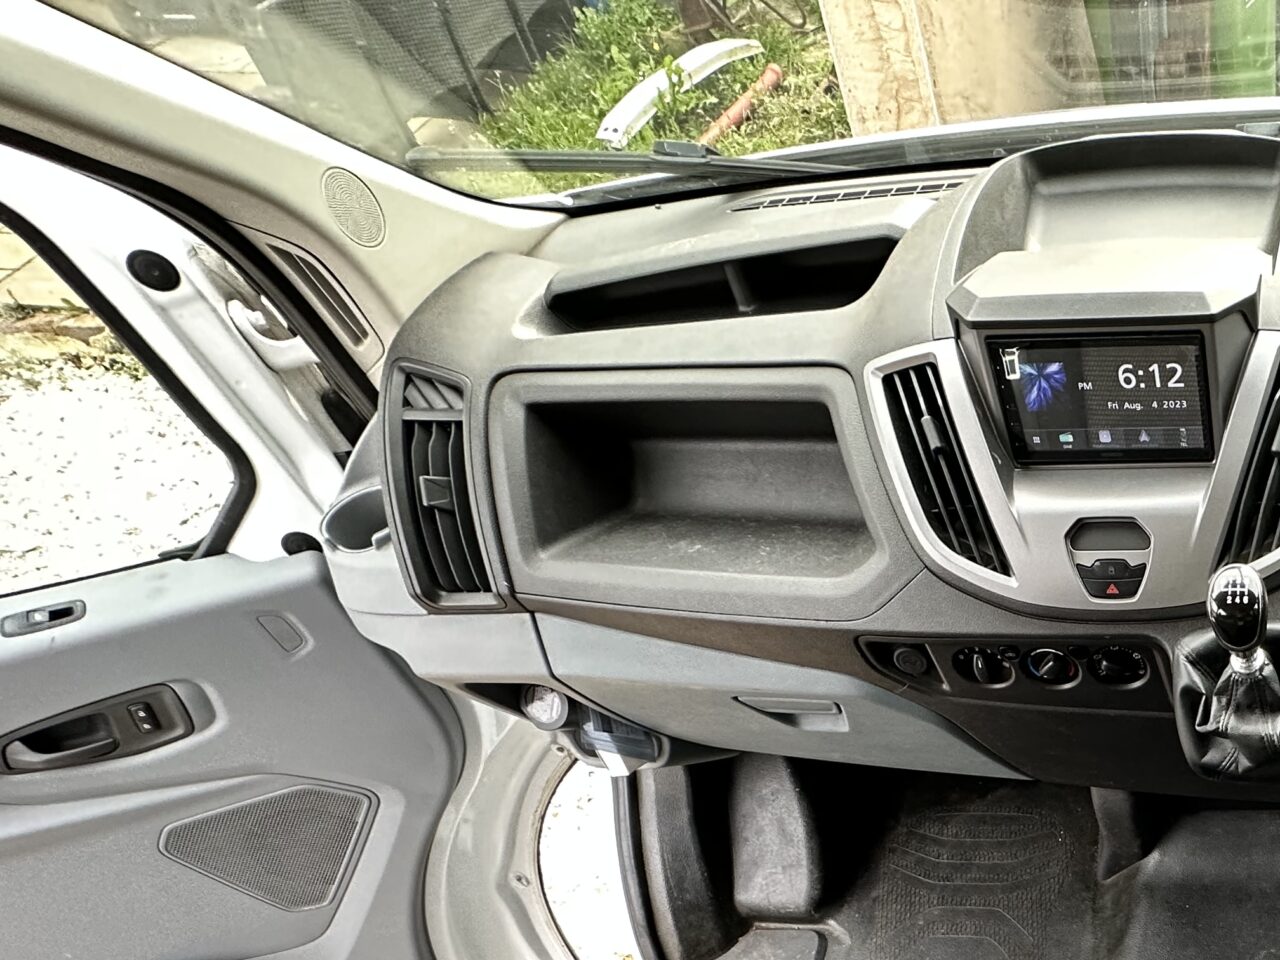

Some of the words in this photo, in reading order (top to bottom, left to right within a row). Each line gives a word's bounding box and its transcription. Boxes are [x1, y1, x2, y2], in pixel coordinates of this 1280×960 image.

[1118, 363, 1185, 389] 6:12
[1078, 382, 1093, 390] PM
[1107, 401, 1119, 409] Fri
[1123, 402, 1144, 411] Aug.
[1152, 401, 1158, 409] 4
[1163, 400, 1187, 409] 2023
[1226, 595, 1232, 604] 2
[1234, 595, 1241, 604] 4
[1242, 595, 1249, 604] 6
